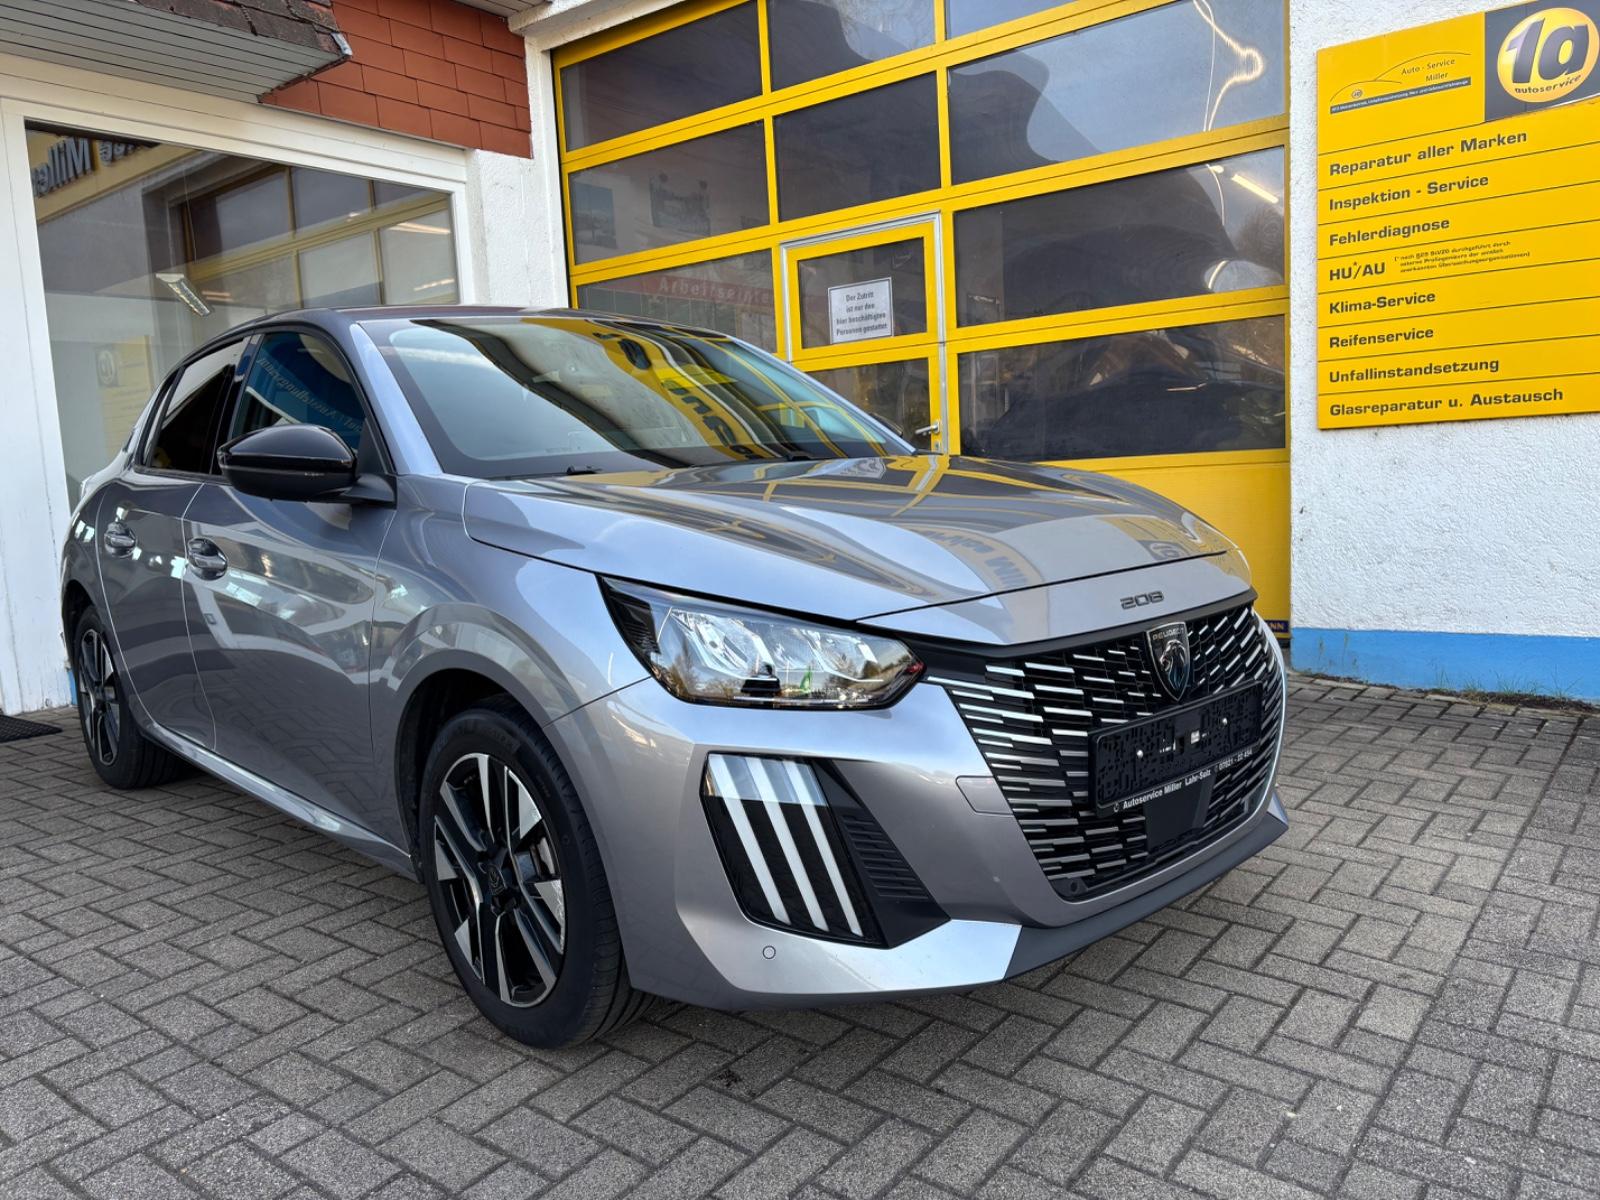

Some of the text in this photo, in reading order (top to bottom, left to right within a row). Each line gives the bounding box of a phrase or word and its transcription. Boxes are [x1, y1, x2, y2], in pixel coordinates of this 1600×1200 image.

[1506, 18, 1590, 84] 1a
[1401, 66, 1420, 76] Auto
[1427, 58, 1456, 70] Service
[1426, 71, 1449, 82] Miller
[1514, 74, 1582, 95] autoservice
[1329, 131, 1527, 176] Reparatur aller Marken
[1329, 186, 1411, 211] Inspektion
[1427, 175, 1489, 195] Service
[1329, 219, 1450, 246] Fehlerdiagnose
[845, 291, 874, 302] Der Zutritt
[864, 302, 875, 310] den
[1329, 291, 1436, 314] Klima-Service
[848, 312, 886, 323] beschäftigten
[836, 327, 862, 336] Personen
[1329, 327, 1434, 348] Reifenservice
[1329, 359, 1500, 383] Unfallinstandsetzung
[1329, 388, 1563, 416] Glasreparatur u. Austausch
[1119, 590, 1165, 610] 208
[1122, 788, 1163, 810] Autoservice
[1163, 782, 1182, 795] Miller
